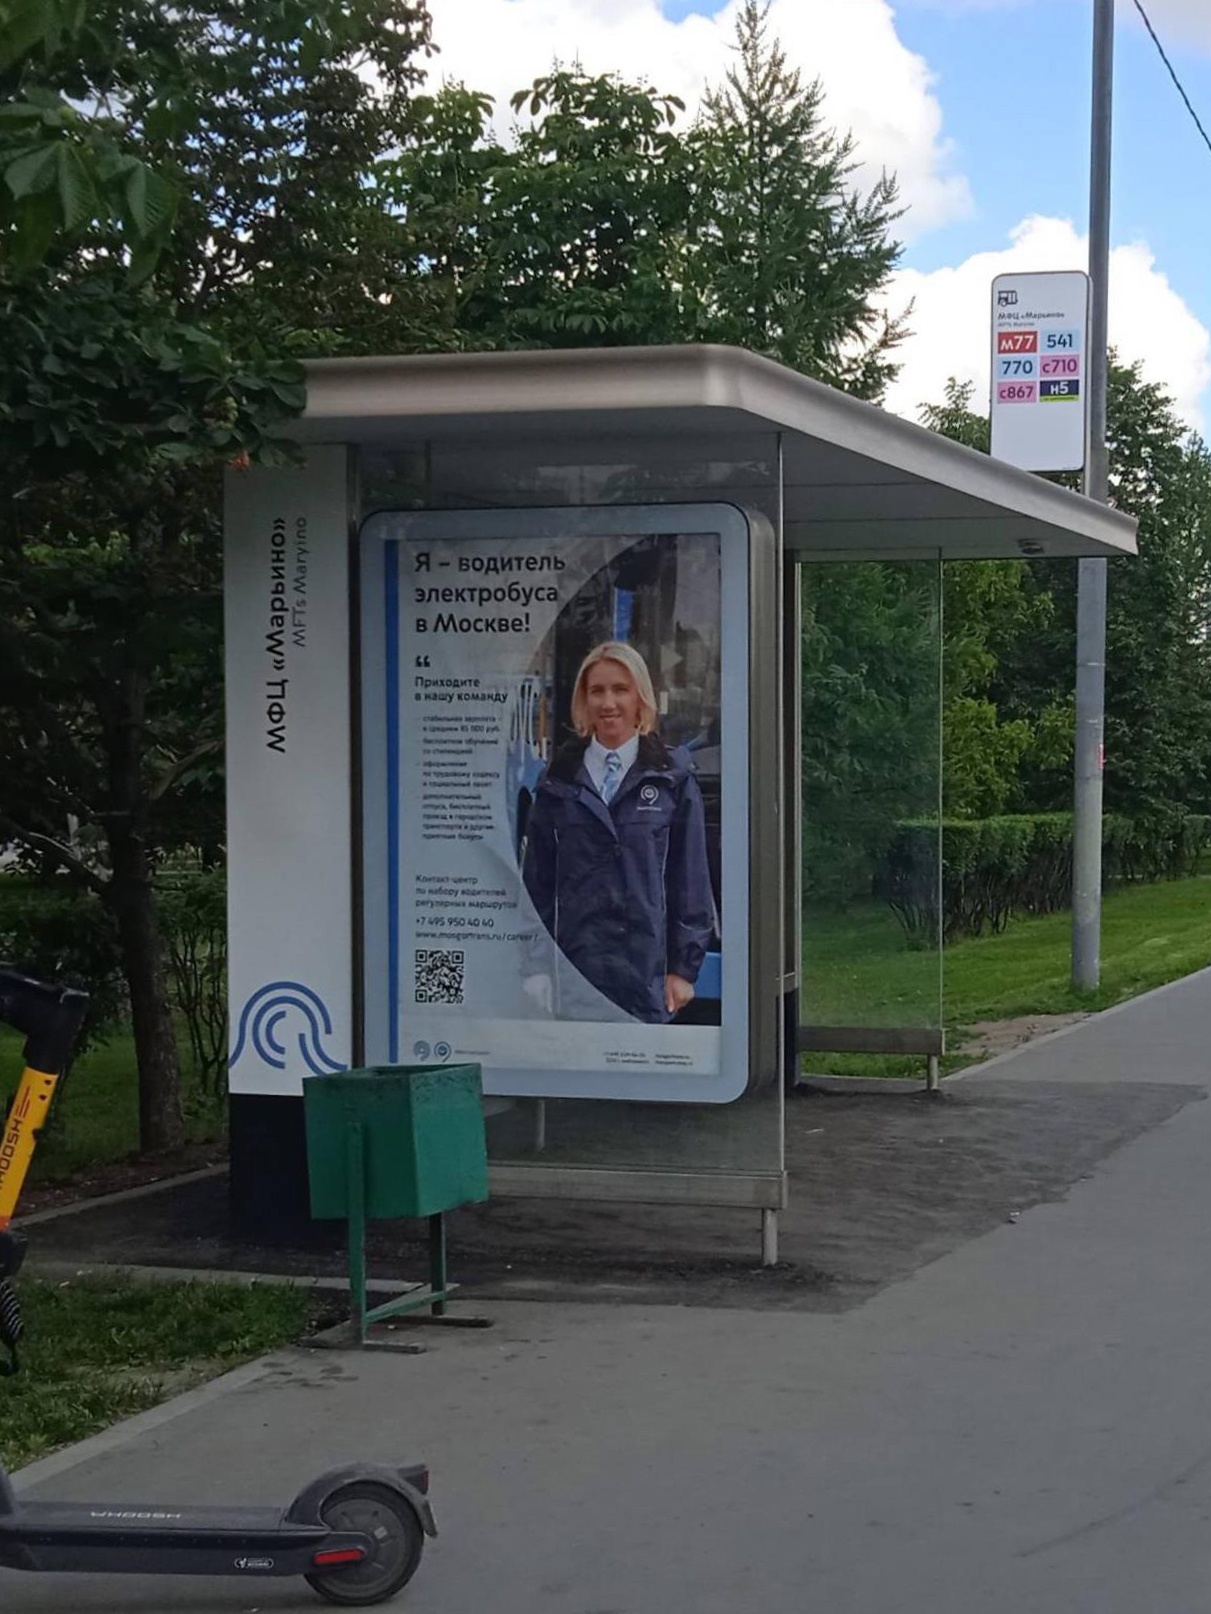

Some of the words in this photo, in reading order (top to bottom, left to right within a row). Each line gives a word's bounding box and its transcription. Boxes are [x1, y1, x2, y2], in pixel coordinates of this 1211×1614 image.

[1047, 333, 1073, 348] 541
[1002, 360, 1033, 375] 770
[292, 517, 310, 594] Maryino
[414, 552, 431, 572] Я
[457, 555, 566, 575] водитель
[265, 517, 289, 671] «Марьино»
[414, 581, 559, 607] электробуса
[292, 599, 307, 648] MFTs
[416, 617, 428, 633] в
[433, 612, 531, 633] Москве!
[415, 676, 480, 688] Приходите
[424, 692, 453, 702] нашу
[457, 693, 508, 703] команду
[265, 679, 289, 753] МФЦ
[447, 917, 465, 926] 950
[467, 918, 479, 927] 40
[481, 918, 494, 927] 40
